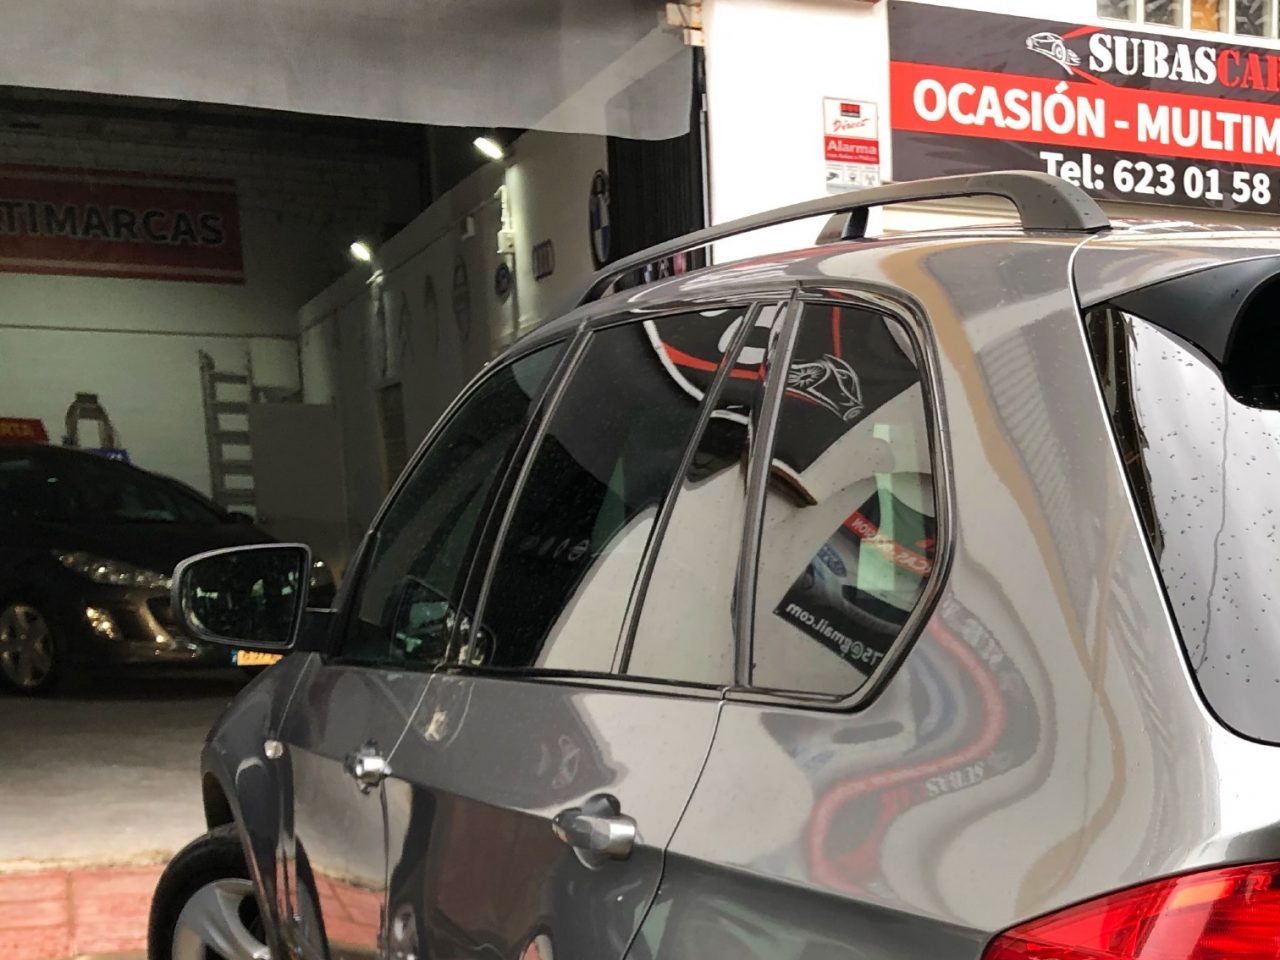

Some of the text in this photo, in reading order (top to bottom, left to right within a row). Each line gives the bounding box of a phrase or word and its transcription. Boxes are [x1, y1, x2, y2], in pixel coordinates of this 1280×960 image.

[912, 81, 1105, 140] OCASIÓN
[826, 139, 878, 156] Alarma
[1112, 159, 1177, 197] 623
[1183, 166, 1224, 202] 01
[1230, 170, 1272, 206] 58
[0, 198, 227, 248] TIMARCAS
